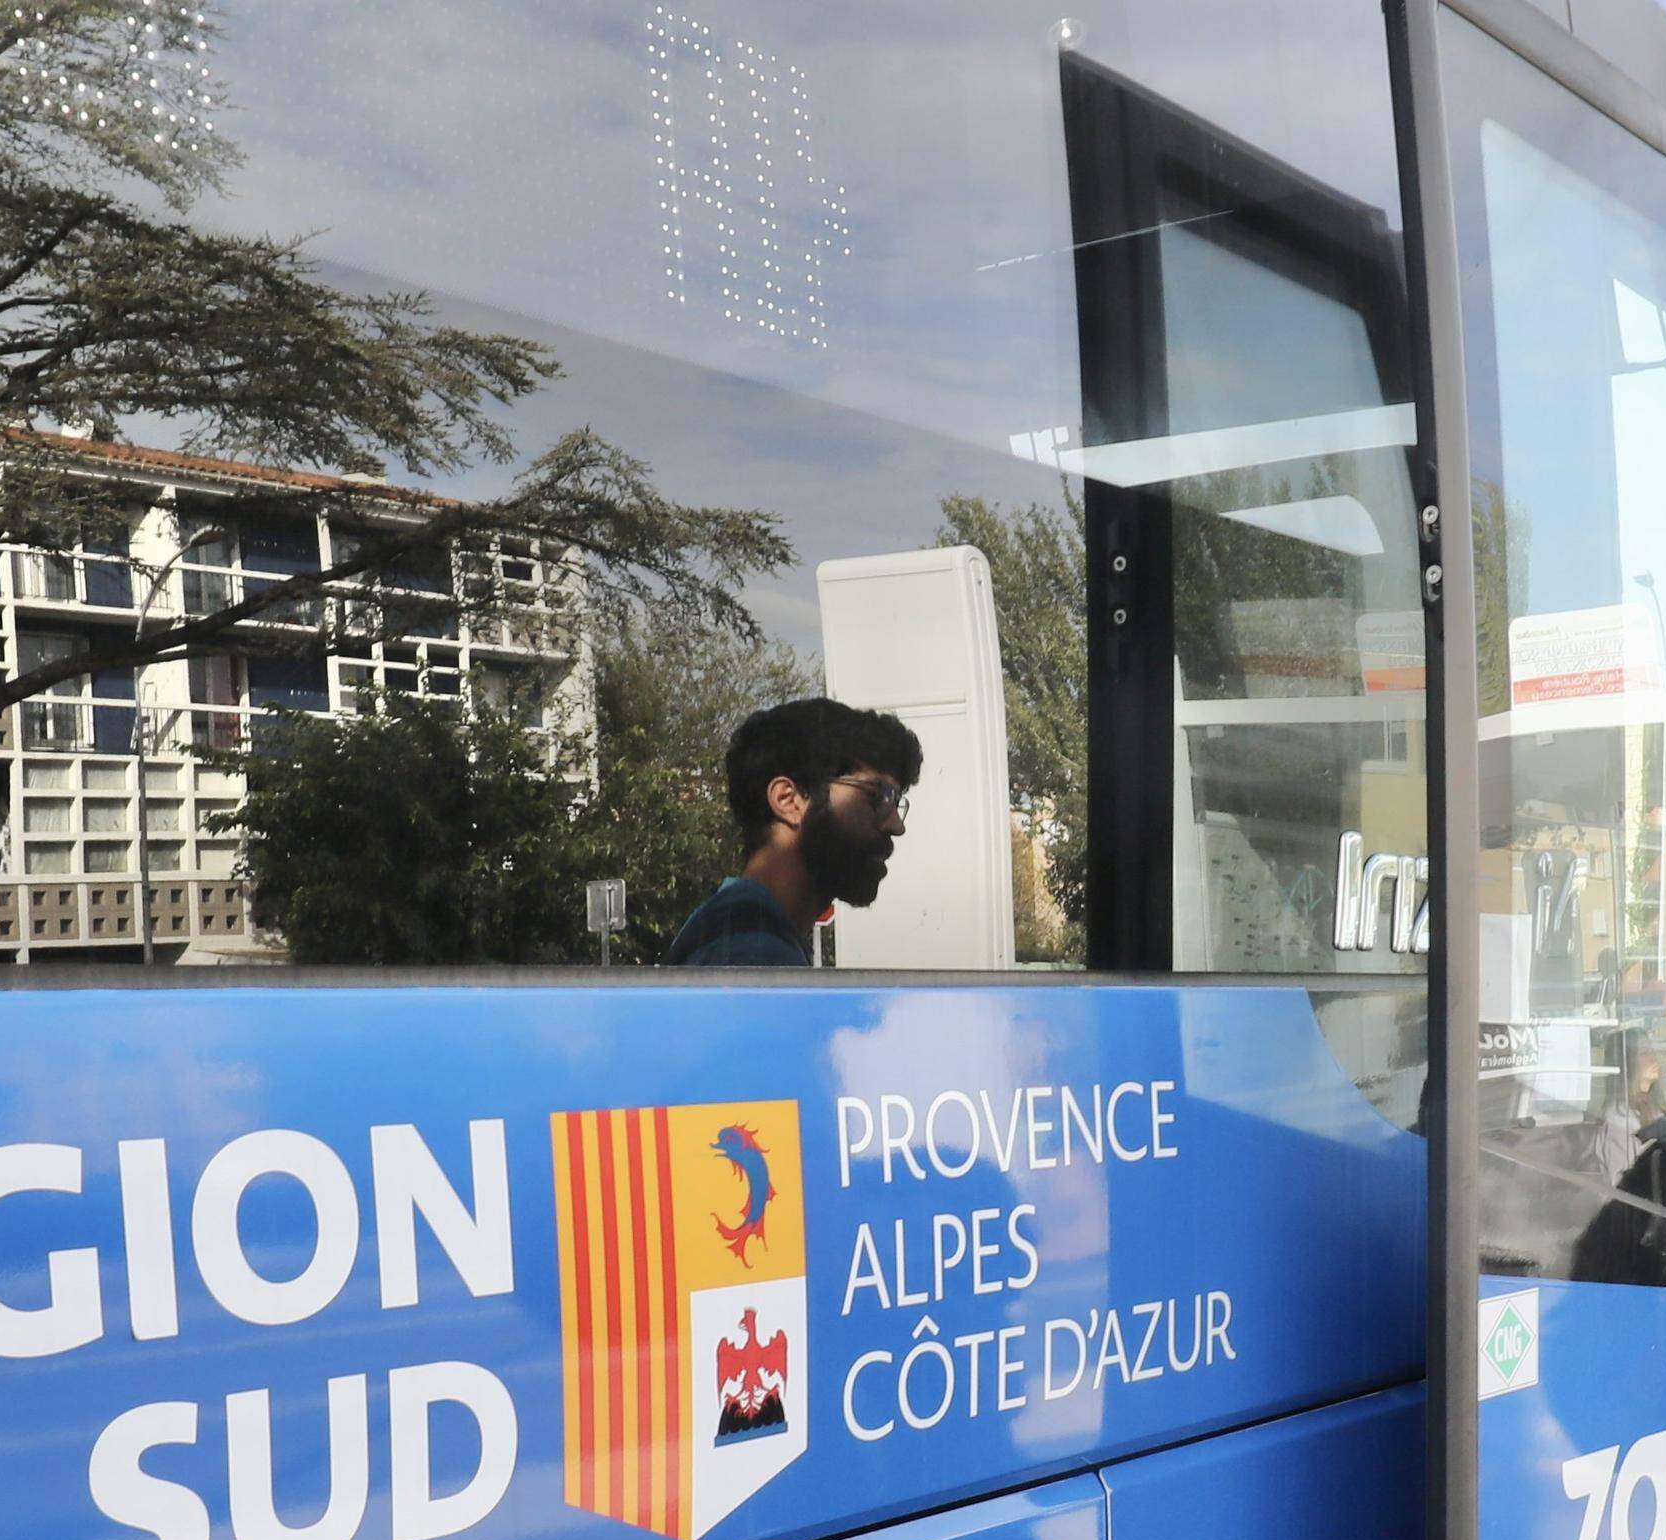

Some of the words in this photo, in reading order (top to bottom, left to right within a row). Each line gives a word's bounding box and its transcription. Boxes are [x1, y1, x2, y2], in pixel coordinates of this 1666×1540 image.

[837, 1080, 1179, 1188] PROVENCE
[841, 1204, 1039, 1317] ALPES
[841, 1315, 1027, 1442] CÔTE
[1042, 1290, 1236, 1402] D'AZUR
[1494, 1323, 1523, 1363] CNG
